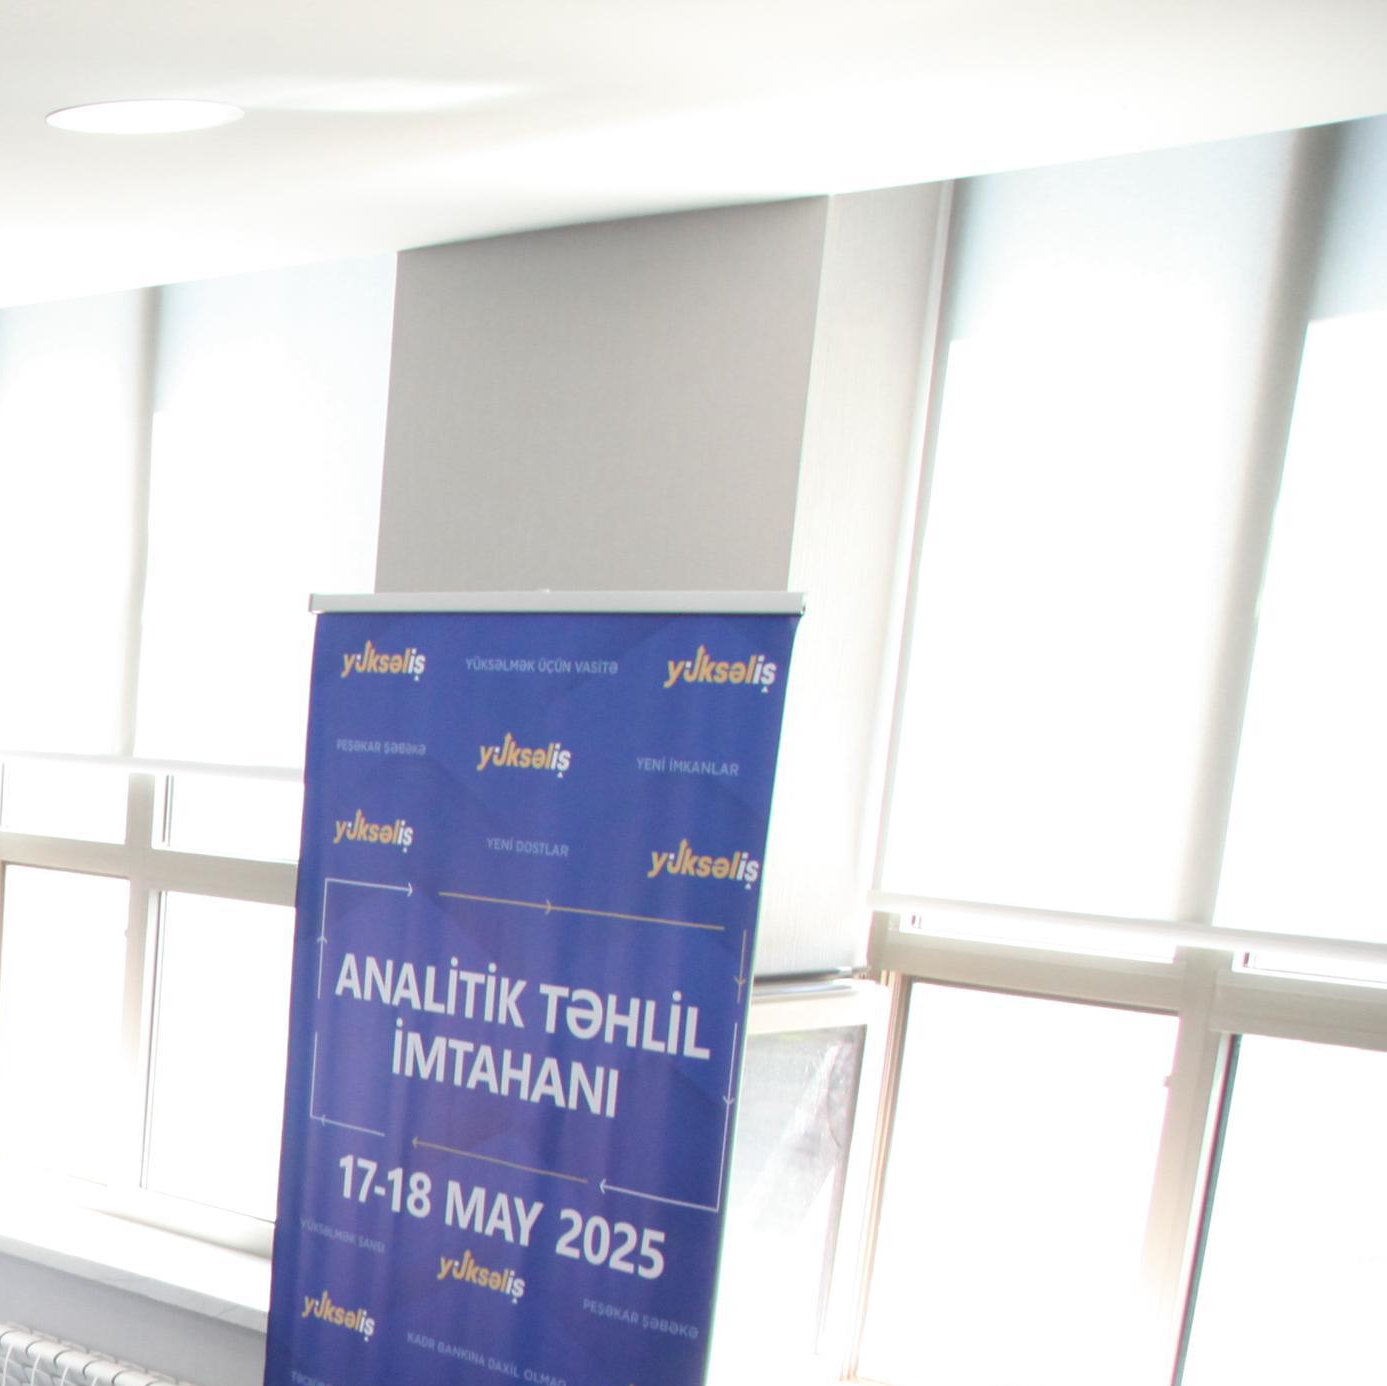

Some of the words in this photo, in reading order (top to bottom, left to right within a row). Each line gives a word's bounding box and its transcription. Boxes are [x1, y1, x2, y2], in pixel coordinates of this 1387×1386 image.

[466, 656, 535, 672] YÜKSƏLMƏK
[538, 657, 571, 675] ÜÇÜN
[574, 658, 618, 675] VASİTƏ
[663, 644, 777, 693] yüksəliş
[476, 732, 572, 778] yüksəliş
[636, 756, 666, 772] YENİ
[669, 757, 740, 777] İMKANLAR
[487, 837, 513, 851] YENİ
[516, 840, 569, 857] DOSTLAR
[647, 838, 759, 889] yüksəliş
[334, 953, 527, 1028] ANALİTİK
[539, 982, 711, 1060] TƏHLİL
[391, 1019, 620, 1118] İMTAHANI
[338, 1154, 433, 1218] 17-18
[444, 1180, 544, 1247] MAY
[555, 1208, 667, 1280] 2025
[437, 1249, 526, 1305] yüksəliş
[583, 1299, 639, 1324] PEŞƏKAR
[642, 1315, 699, 1340] ŞƏBƏKƏ
